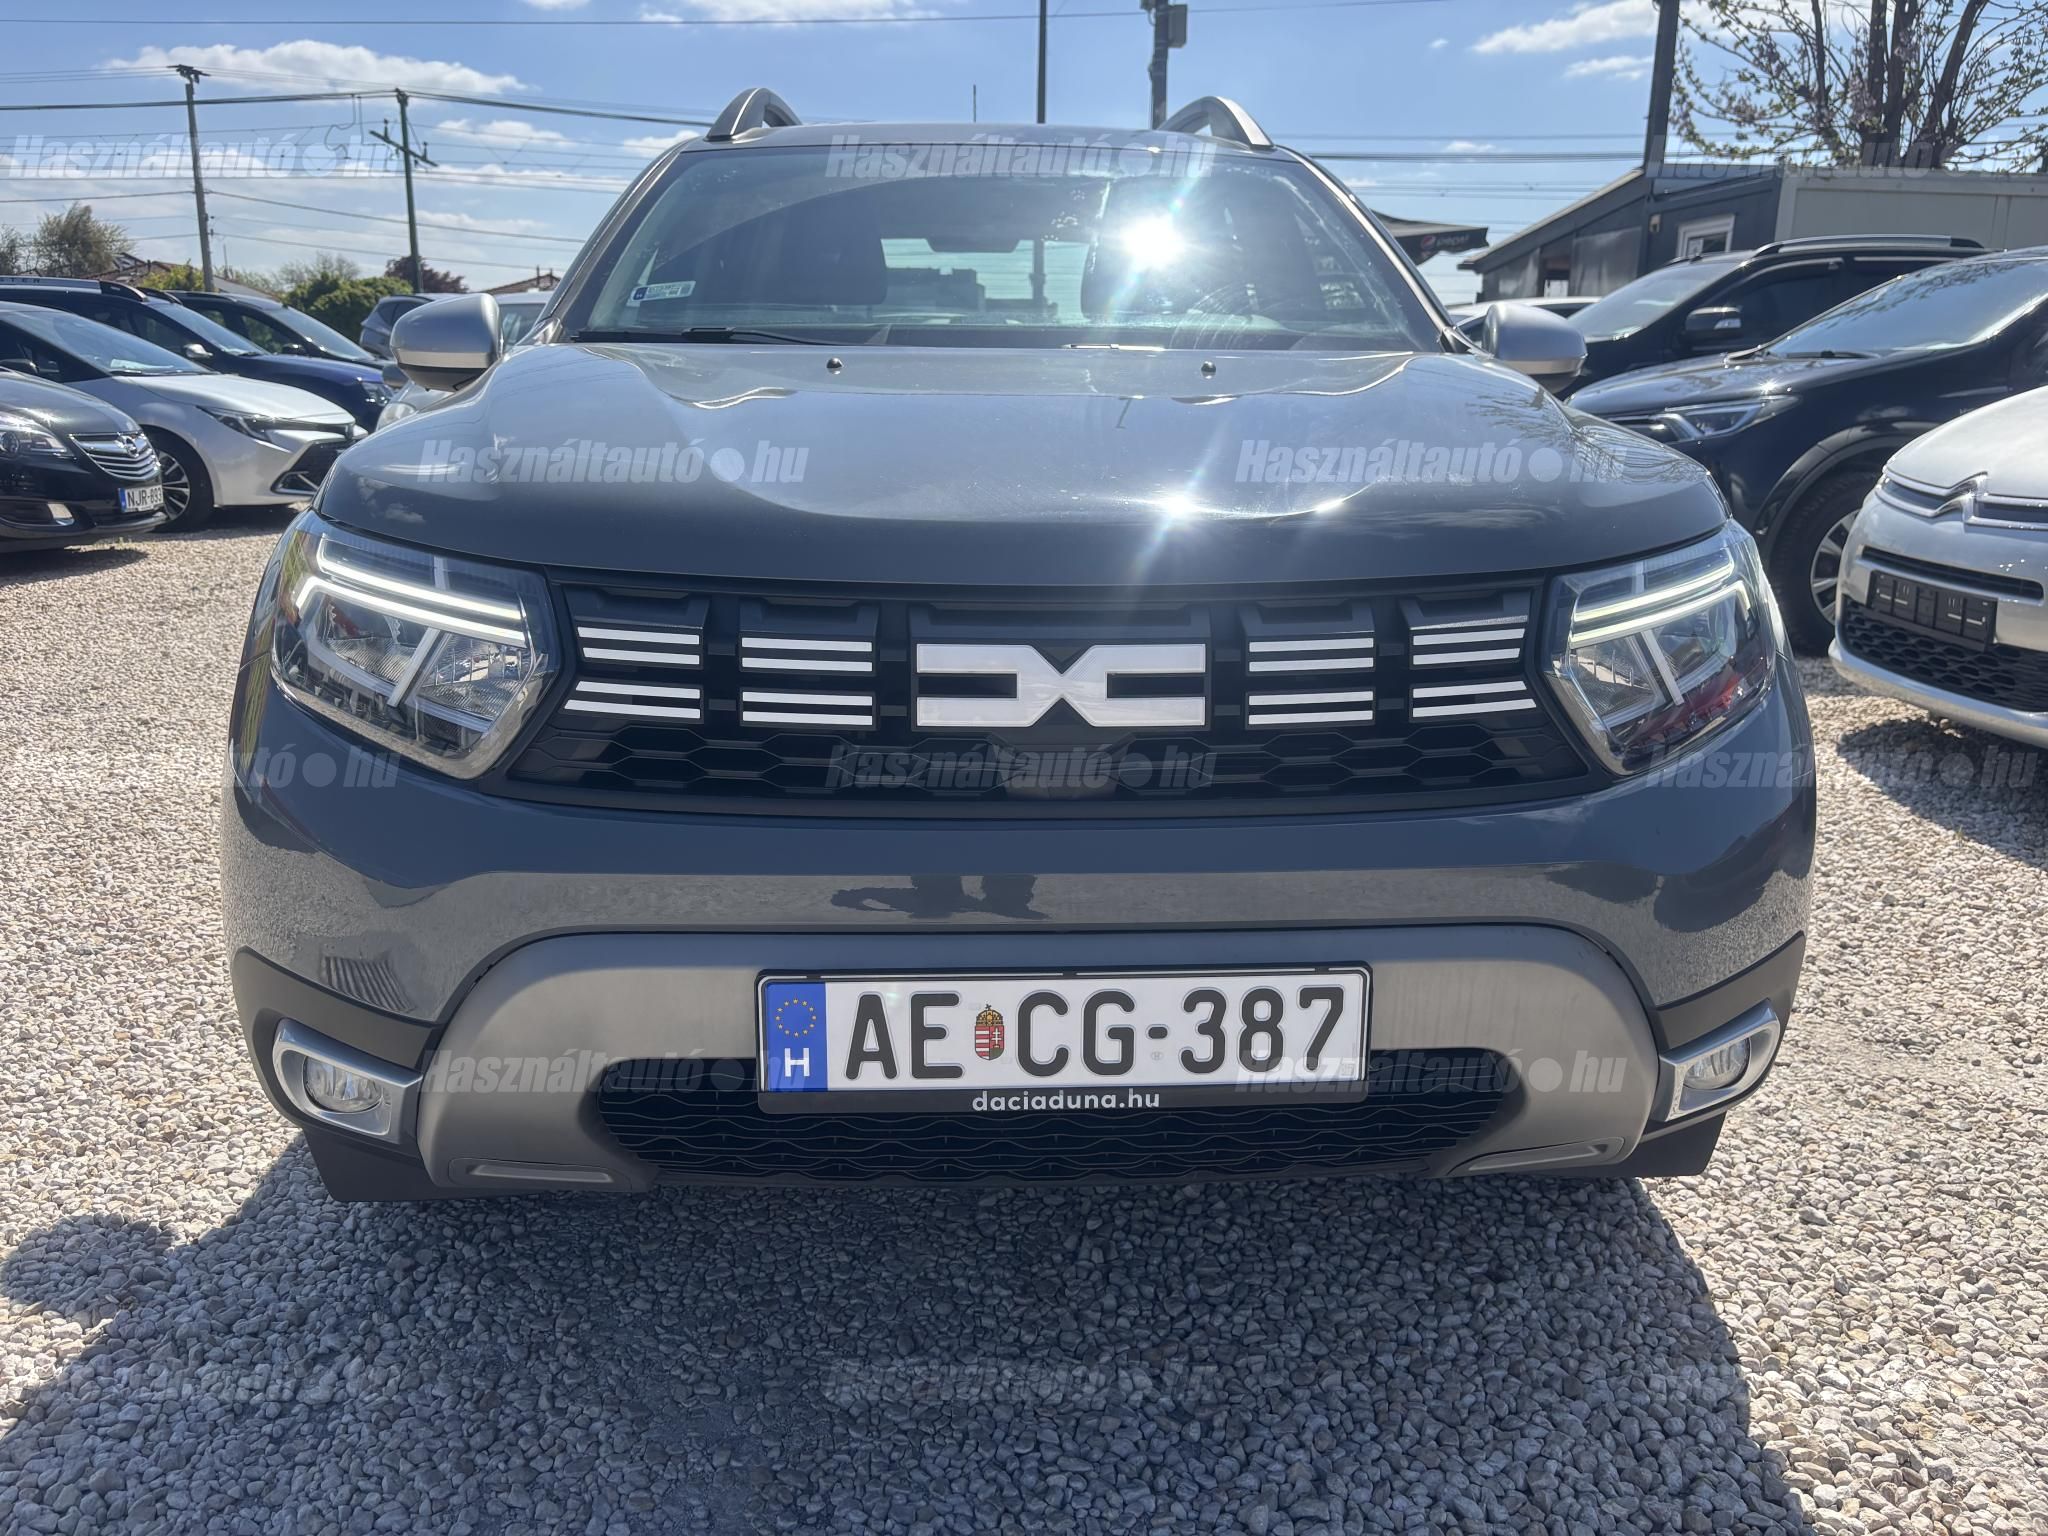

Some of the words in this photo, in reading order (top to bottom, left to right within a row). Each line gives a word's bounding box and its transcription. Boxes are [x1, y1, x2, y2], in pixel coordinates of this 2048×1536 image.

[845, 991, 965, 1080] AE
[1016, 986, 1345, 1078] CG-387
[784, 1047, 810, 1078] H
[972, 1088, 1160, 1111] daciaduna.hu
